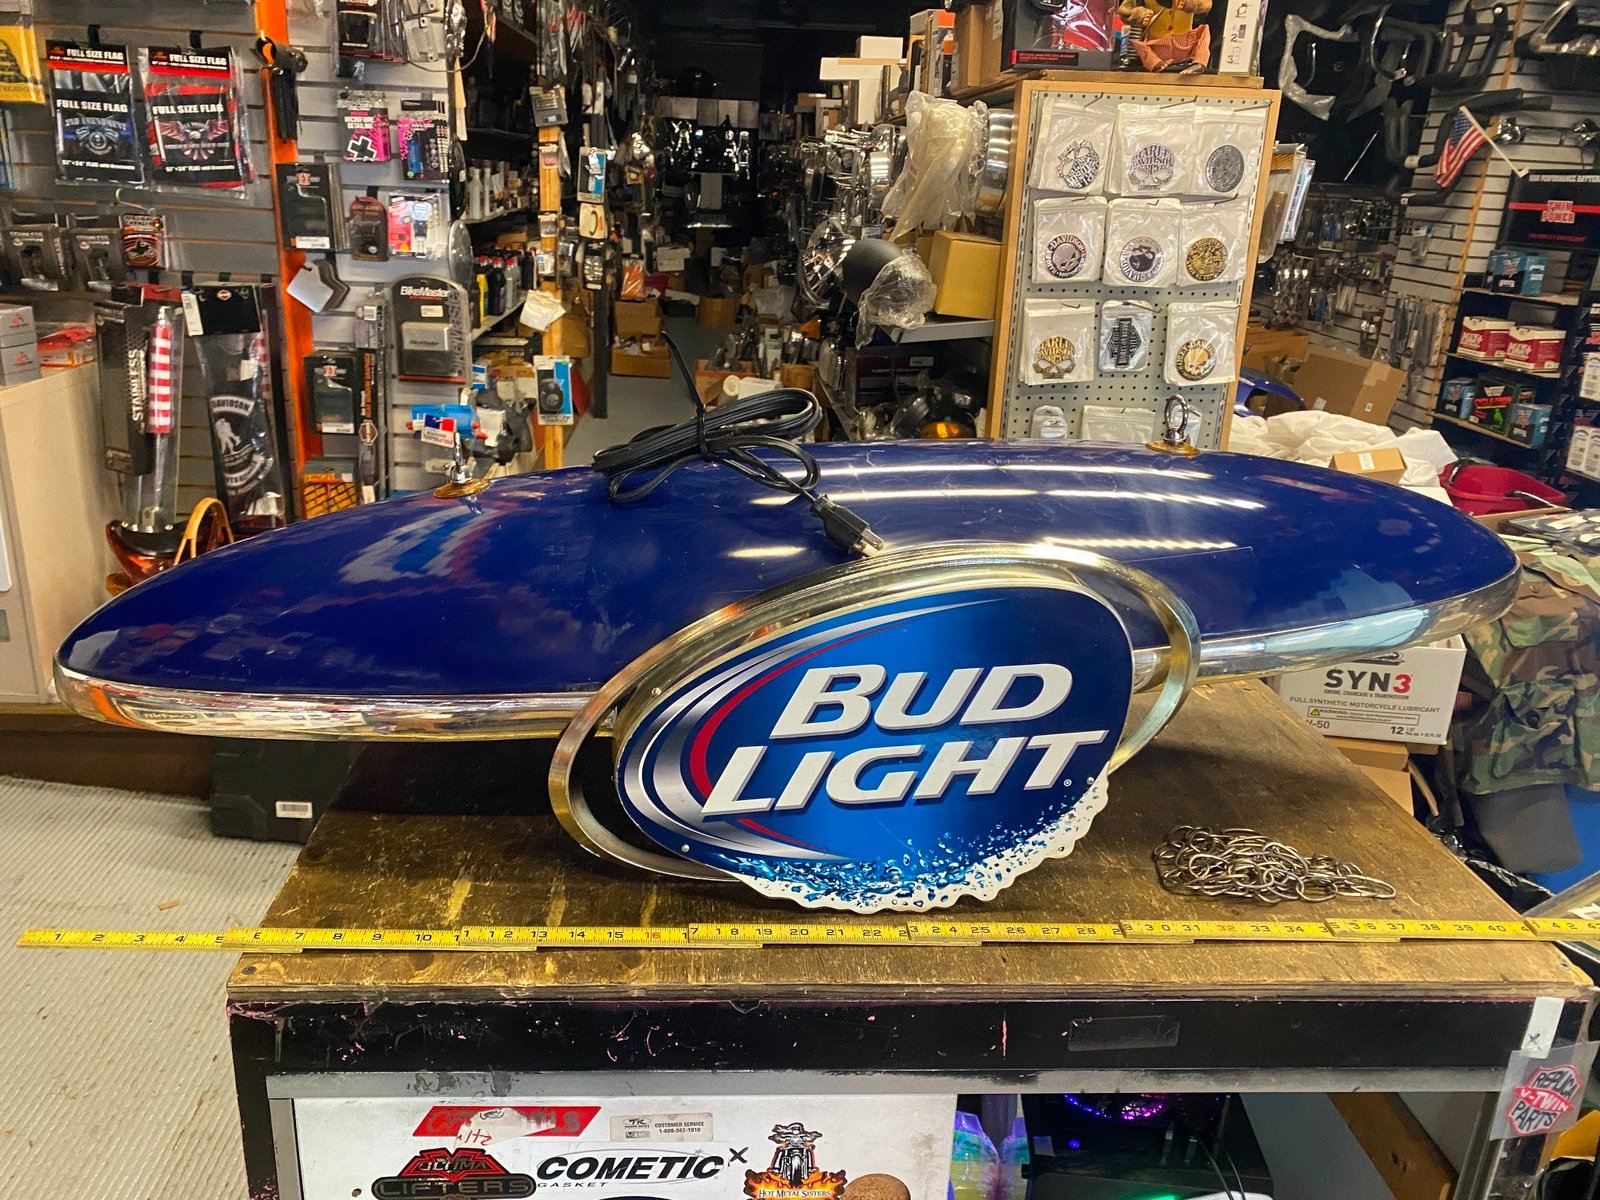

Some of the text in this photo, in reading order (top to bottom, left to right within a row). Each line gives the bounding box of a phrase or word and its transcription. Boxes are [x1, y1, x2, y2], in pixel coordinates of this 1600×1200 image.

[1230, 34, 1238, 42] 2
[66, 48, 85, 58] FULL
[85, 49, 103, 59] SIZE
[104, 51, 124, 60] FLAG
[169, 53, 188, 63] FULL
[189, 55, 206, 64] SIZE
[207, 56, 227, 66] FLAG
[1227, 55, 1234, 64] 3
[56, 99, 129, 113] FULL SIZE FLAG
[152, 103, 224, 115] FULL SIZE FLAG
[1542, 211, 1575, 223] POWER
[400, 286, 451, 298] BikeMaster
[127, 349, 143, 421] STAINLESS
[1324, 667, 1412, 694] SYN3
[769, 664, 1073, 739] BUD
[1309, 698, 1348, 706] SYNTHETIC
[1349, 702, 1397, 711] MOTORCYCLE
[1398, 704, 1440, 713] LUBRICANT
[1391, 726, 1405, 735] 12
[701, 730, 1110, 816] LIGHT
[93, 934, 104, 942] 2
[175, 935, 185, 943] 4
[295, 932, 304, 940] 7
[416, 934, 432, 942] 10
[757, 928, 772, 936] 19
[790, 928, 808, 936] 20
[972, 926, 990, 934] 25
[1077, 927, 1095, 935] 28
[1183, 924, 1201, 932] 31
[1489, 924, 1507, 932] 40
[1530, 1069, 1579, 1100] REPLICA
[1520, 1087, 1569, 1113] V-TWIN
[1511, 1100, 1556, 1132] PARTS
[537, 1156, 725, 1180] COMETIC
[380, 1181, 529, 1196] LIFTERS
[759, 1189, 831, 1198] HOT METAL SISTERS
